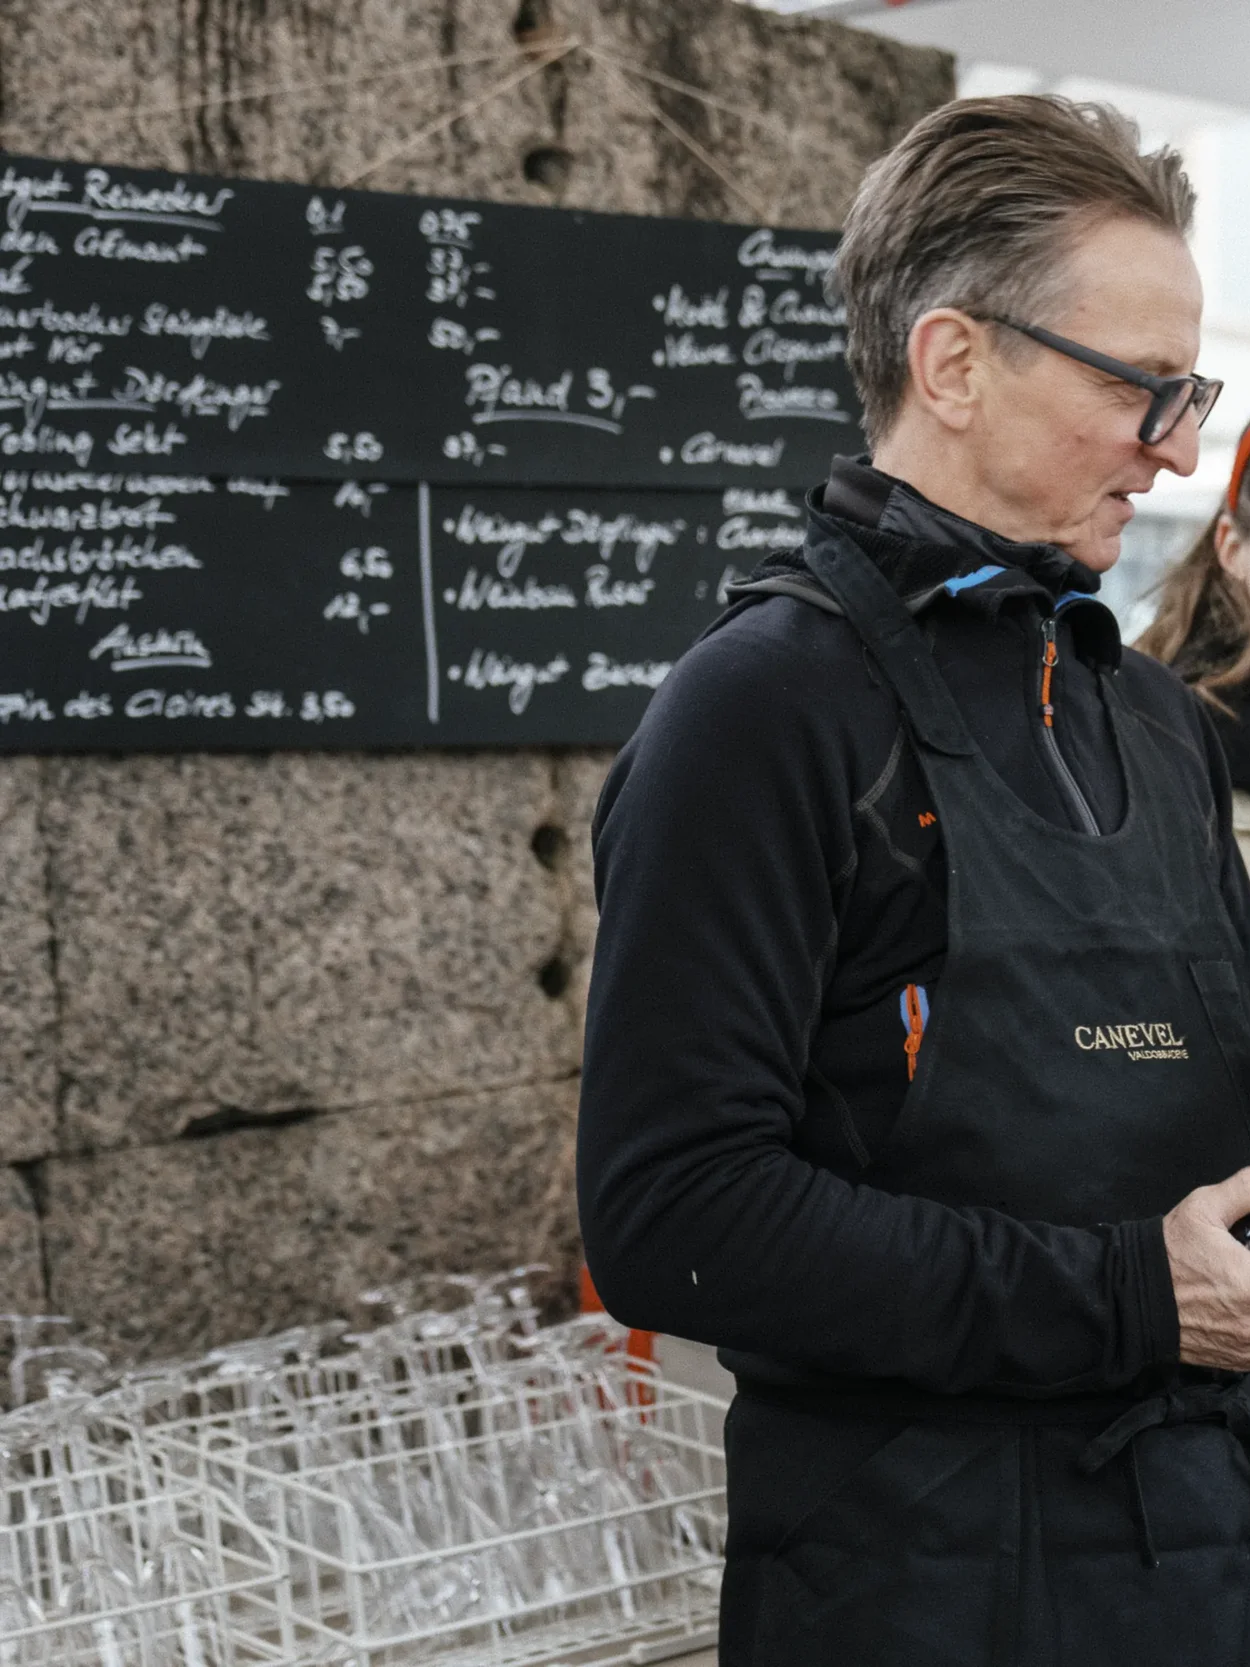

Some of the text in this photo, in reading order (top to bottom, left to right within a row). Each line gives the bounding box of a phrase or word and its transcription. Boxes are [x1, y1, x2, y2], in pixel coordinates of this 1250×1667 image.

[106, 420, 188, 456] Sekt
[0, 535, 205, 575] achsbrötchen
[1074, 1022, 1185, 1050] CANEVEL
